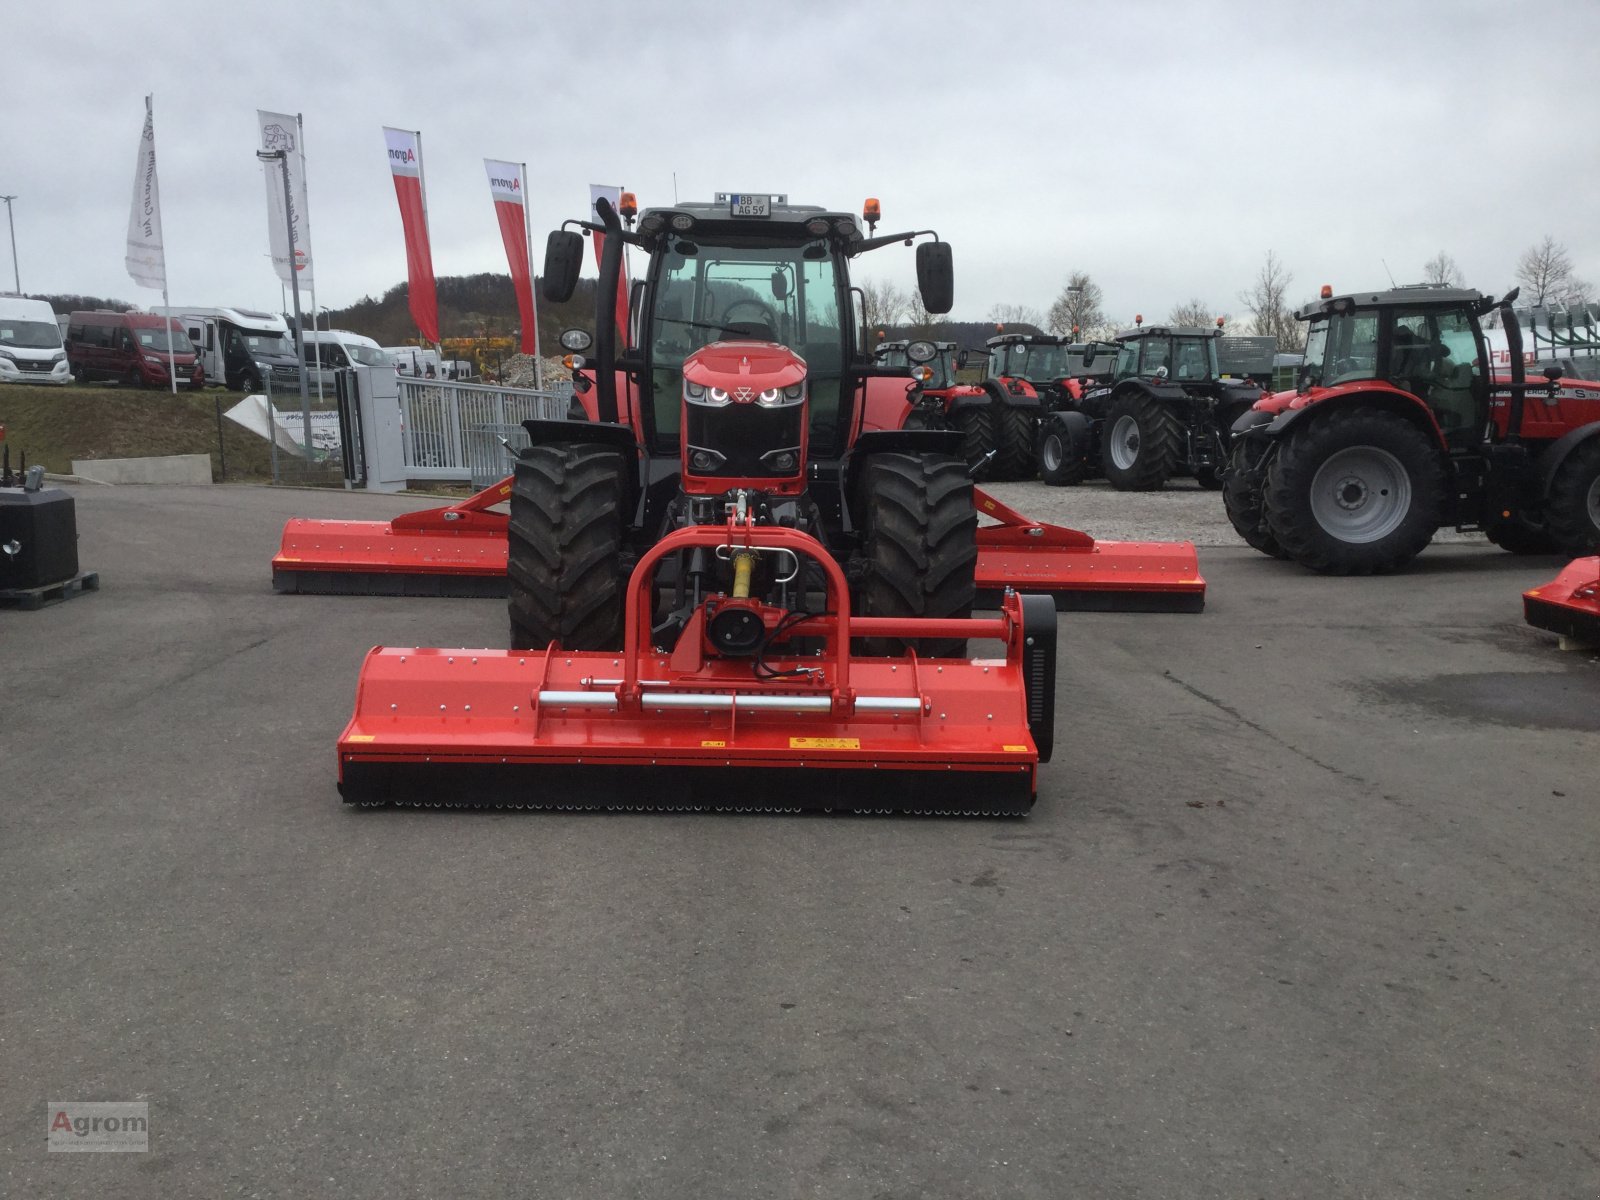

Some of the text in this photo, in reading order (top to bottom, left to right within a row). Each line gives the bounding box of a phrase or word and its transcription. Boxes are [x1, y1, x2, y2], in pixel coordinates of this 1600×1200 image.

[740, 196, 753, 205] BB
[738, 205, 765, 215] AG 59
[1575, 389, 1586, 398] S
